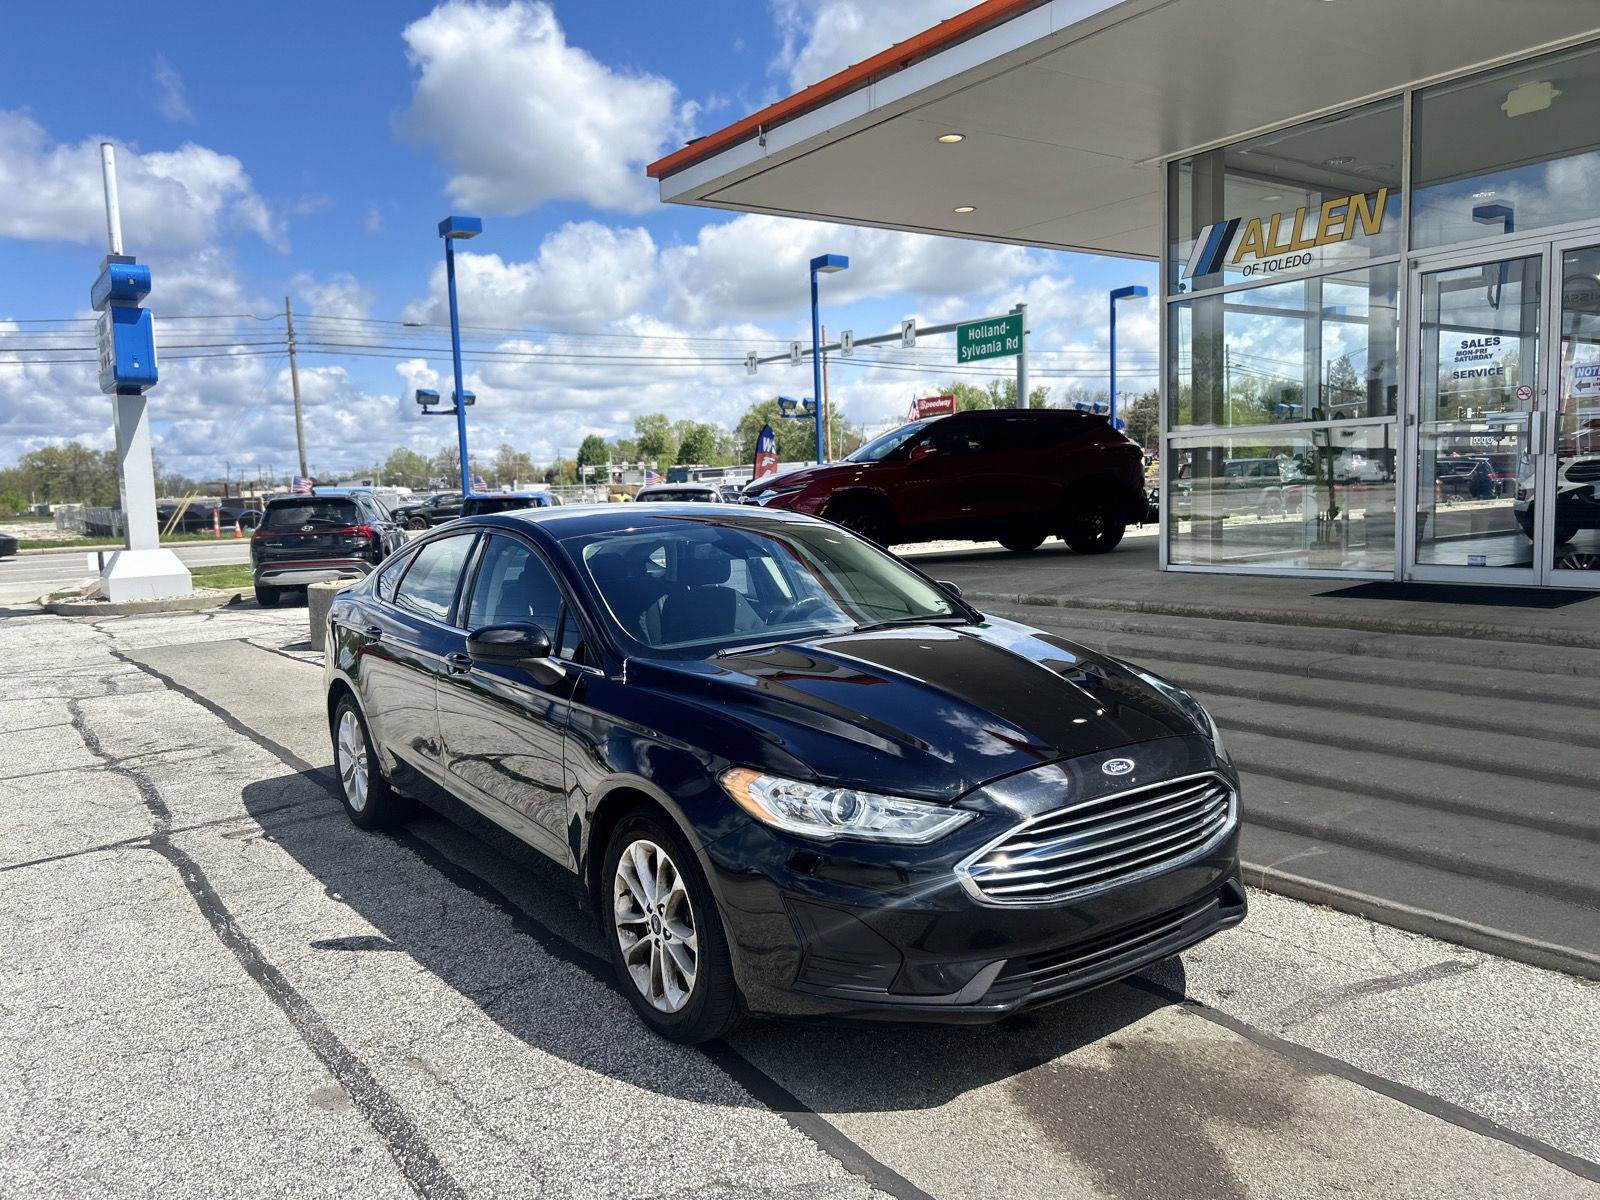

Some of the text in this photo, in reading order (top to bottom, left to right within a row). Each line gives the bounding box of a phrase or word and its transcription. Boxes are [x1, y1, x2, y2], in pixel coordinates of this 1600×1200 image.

[1232, 187, 1387, 264] ALLEN
[1242, 252, 1312, 277] OF TOLEDO
[969, 321, 1009, 339] Holland-
[962, 336, 1018, 359] Sylvania Rd
[1461, 337, 1500, 349] SALES
[1454, 353, 1493, 362] SATURDAY
[1456, 348, 1487, 356] MON-FRI
[1453, 367, 1503, 379] SERVICE
[919, 398, 952, 410] Speedway
